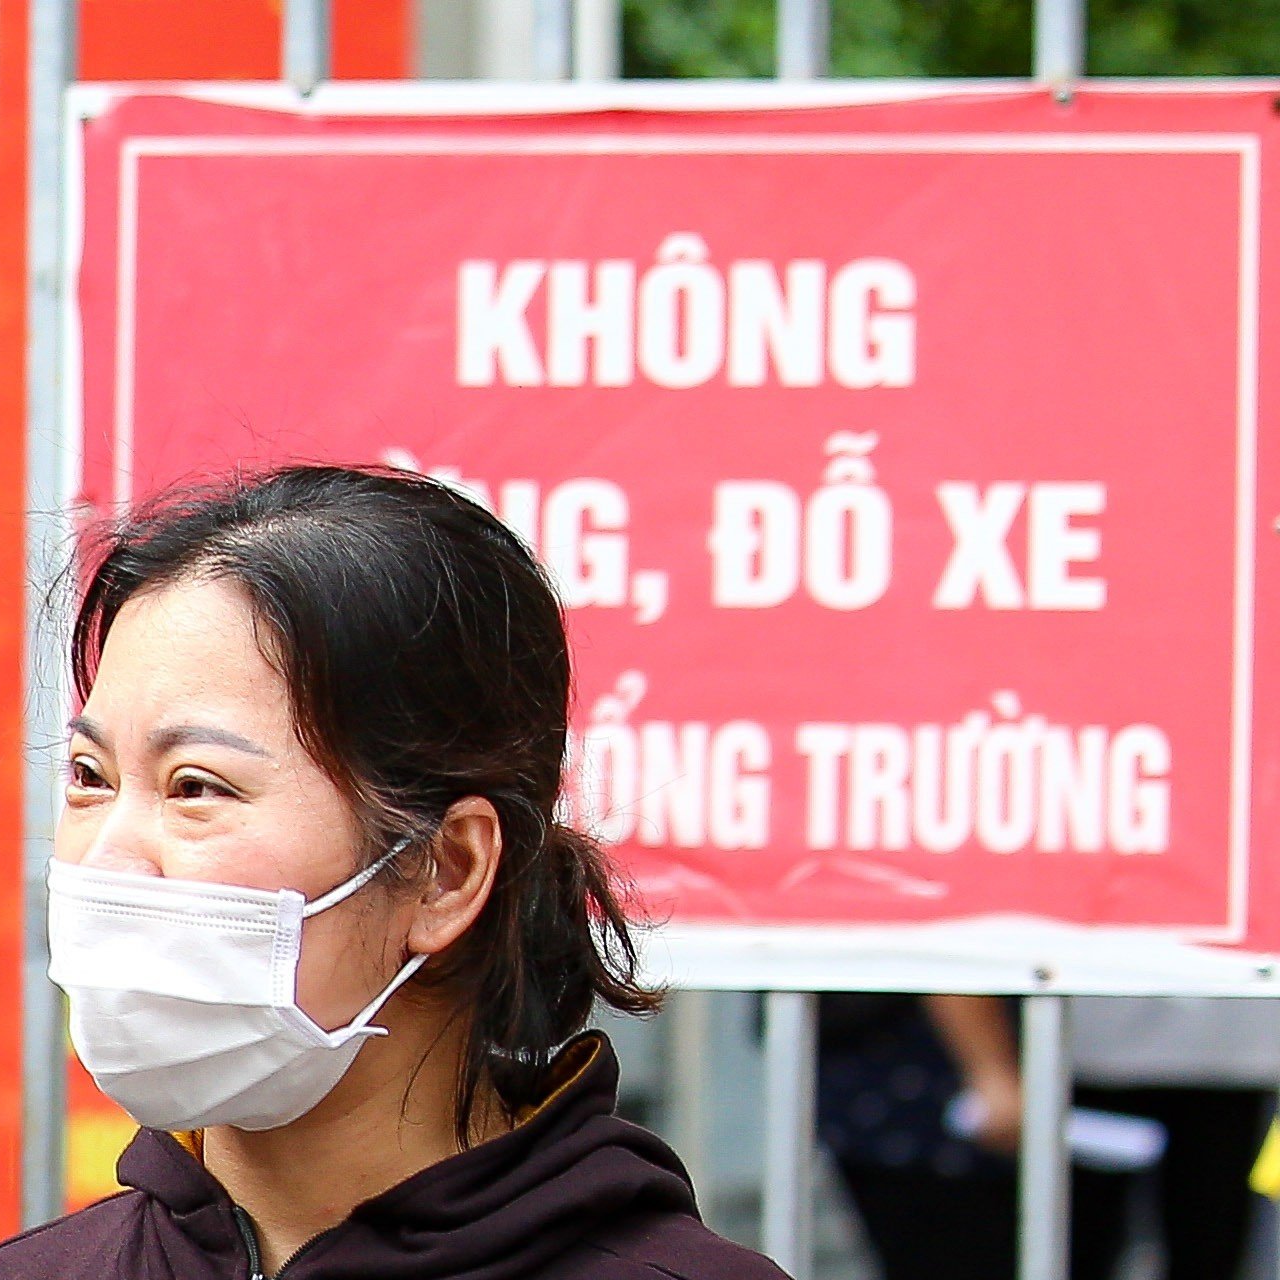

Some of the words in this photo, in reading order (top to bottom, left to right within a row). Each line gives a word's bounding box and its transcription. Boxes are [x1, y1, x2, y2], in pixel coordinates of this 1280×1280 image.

[456, 232, 917, 388] KHÔNG
[708, 432, 893, 611] ĐỖ
[934, 481, 1107, 611] XE
[795, 691, 1171, 855] TRƯỜNG
